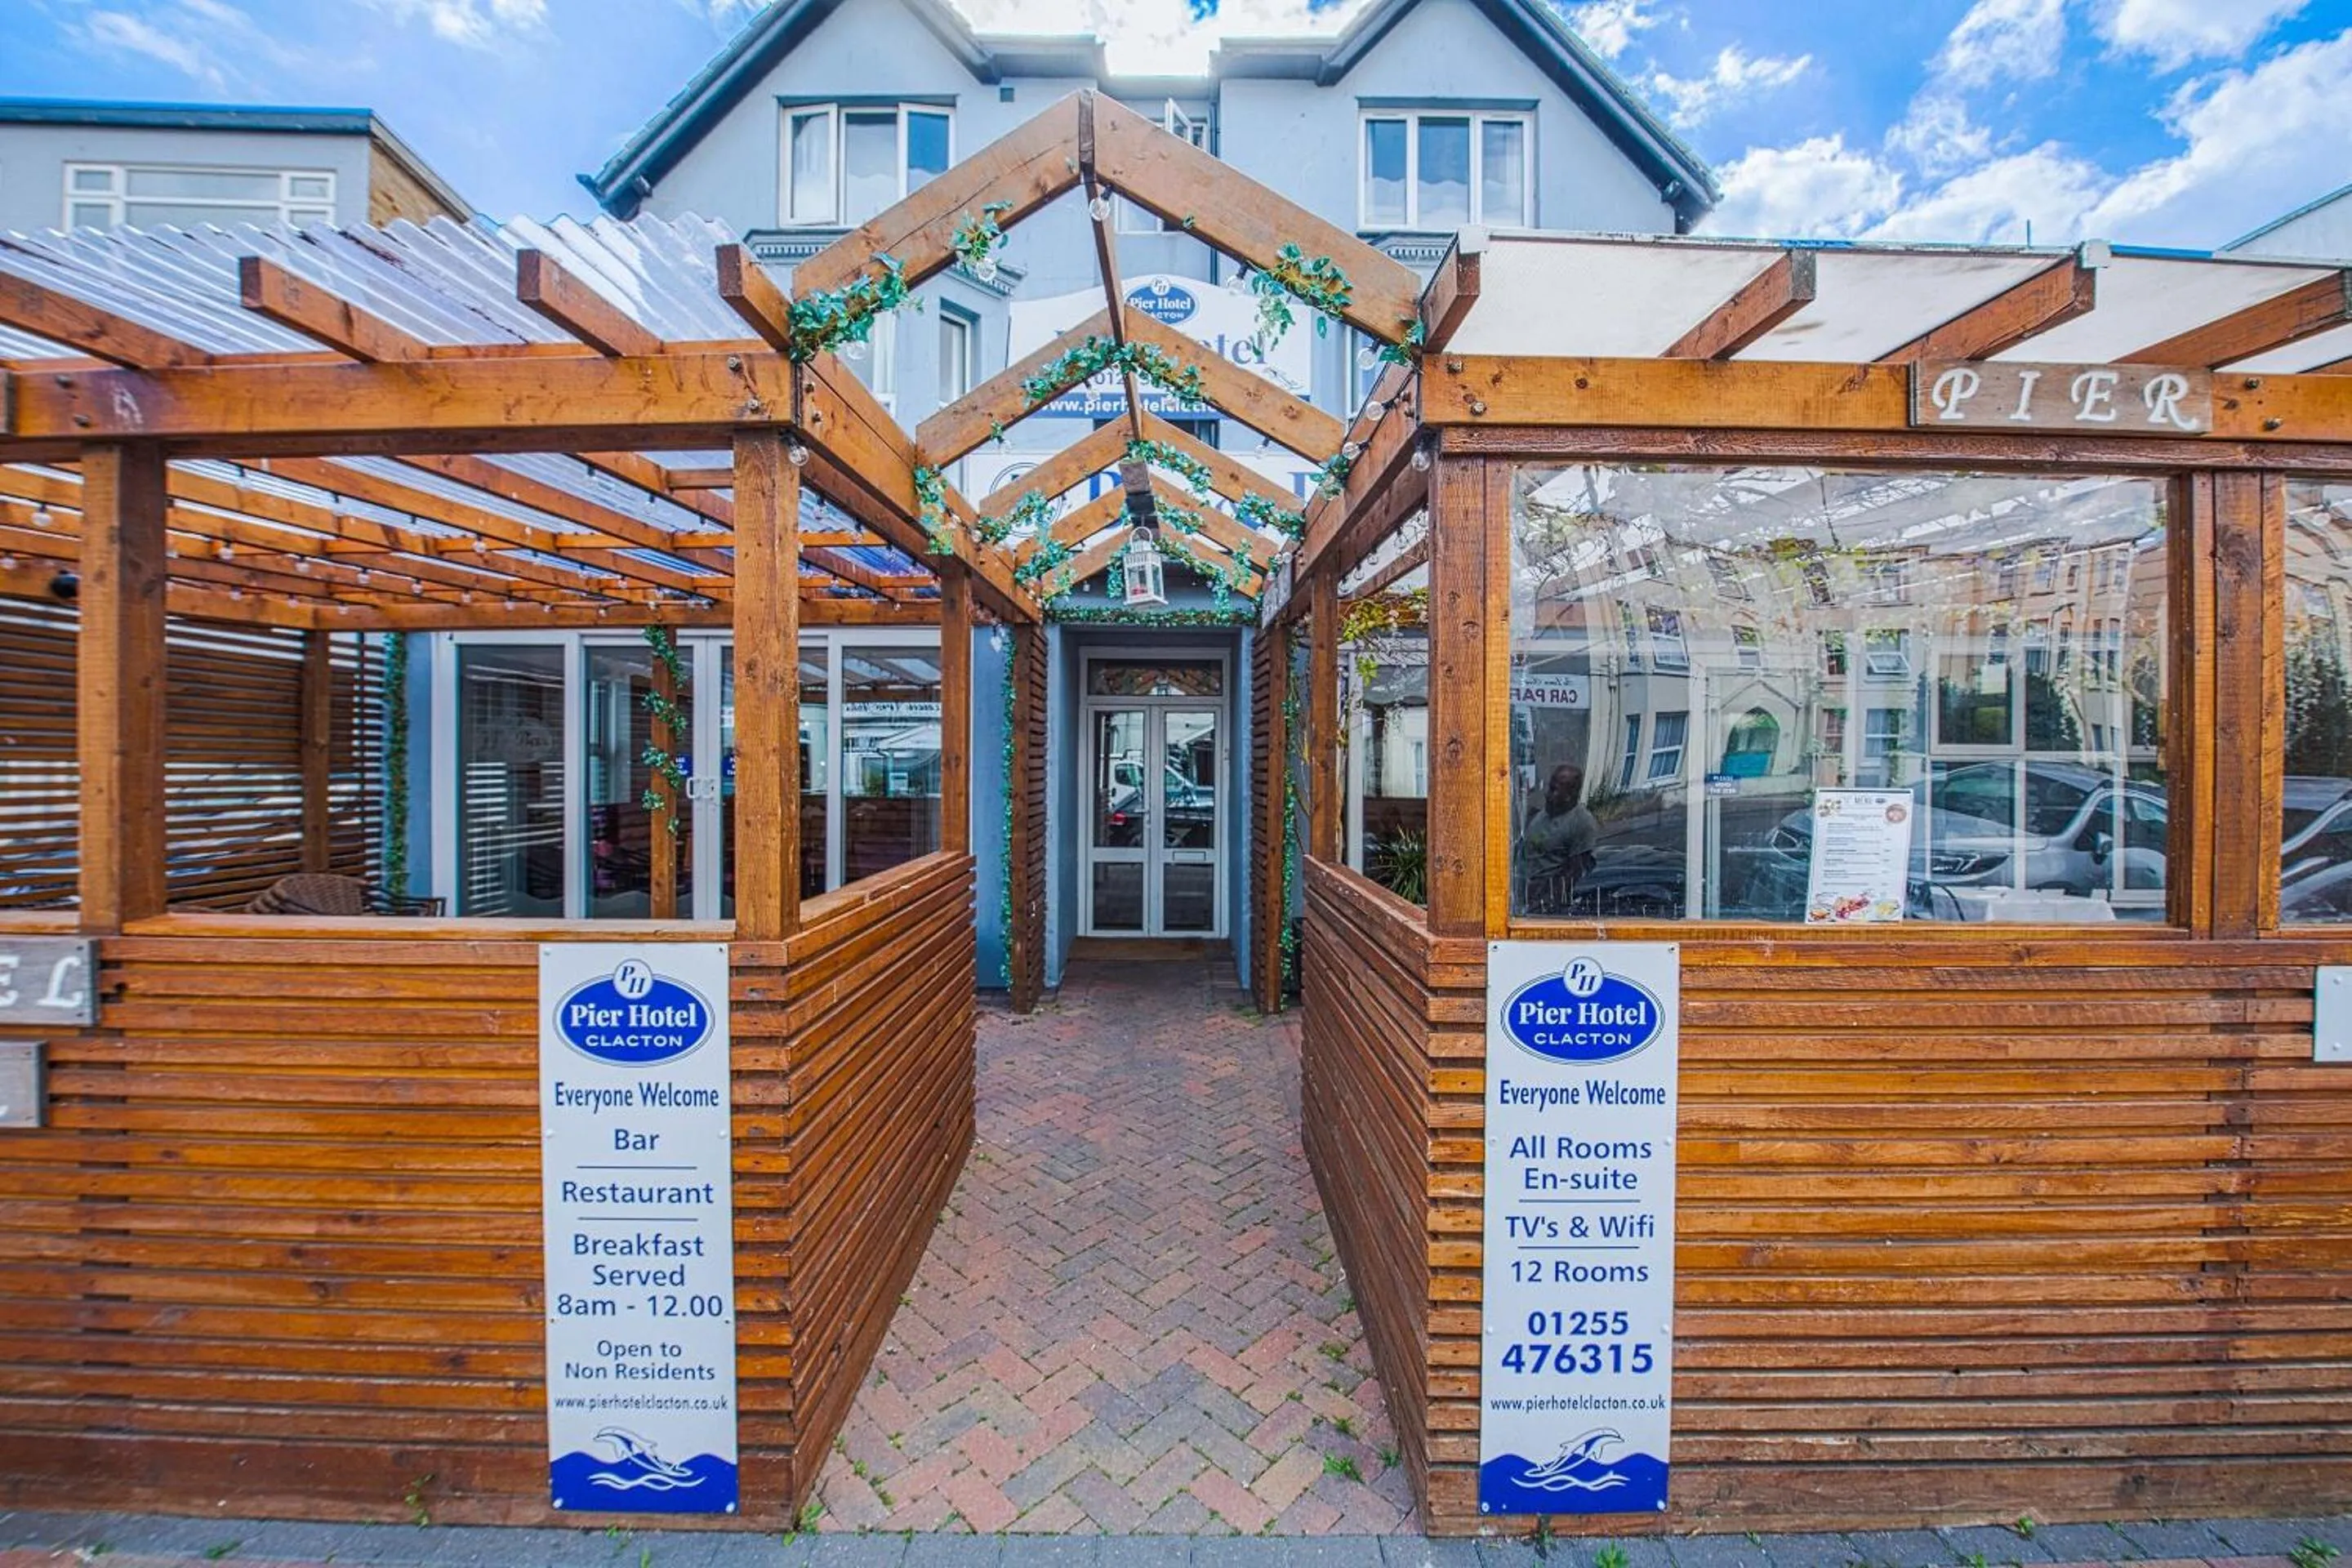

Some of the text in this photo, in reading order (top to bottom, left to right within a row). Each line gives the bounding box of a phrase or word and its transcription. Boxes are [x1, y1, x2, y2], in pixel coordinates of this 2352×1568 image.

[1129, 296, 1191, 310] Pier Hotel
[1932, 368, 2199, 430] PIER
[570, 1003, 697, 1027] Pier Hotel
[1518, 1000, 1646, 1025] Pier Hotel
[585, 1034, 684, 1047] CLACTON
[1534, 1032, 1632, 1045] CLACTON
[555, 1081, 719, 1115] Everyone Welcome
[1499, 1079, 1666, 1113] Everyone Welcome
[614, 1128, 660, 1151] Bar
[1509, 1134, 1652, 1160] All Rooms
[1525, 1166, 1638, 1190] En-suite
[562, 1181, 715, 1205] Restaurant
[1504, 1214, 1655, 1238] TV's & Wifi
[574, 1232, 704, 1257] Breakfast
[593, 1263, 685, 1287] Served
[1511, 1260, 1649, 1283] 12 Rooms
[557, 1294, 617, 1316] 8am
[647, 1294, 723, 1317] 12.00
[1528, 1311, 1628, 1336] 01255
[597, 1339, 682, 1361] Open to
[1501, 1343, 1653, 1374] 476315
[565, 1361, 715, 1381] Non Residents
[555, 1394, 728, 1413] www.pierhotelclacton.co.uk
[1490, 1394, 1665, 1414] www.pierhotelclacton.co.uk
